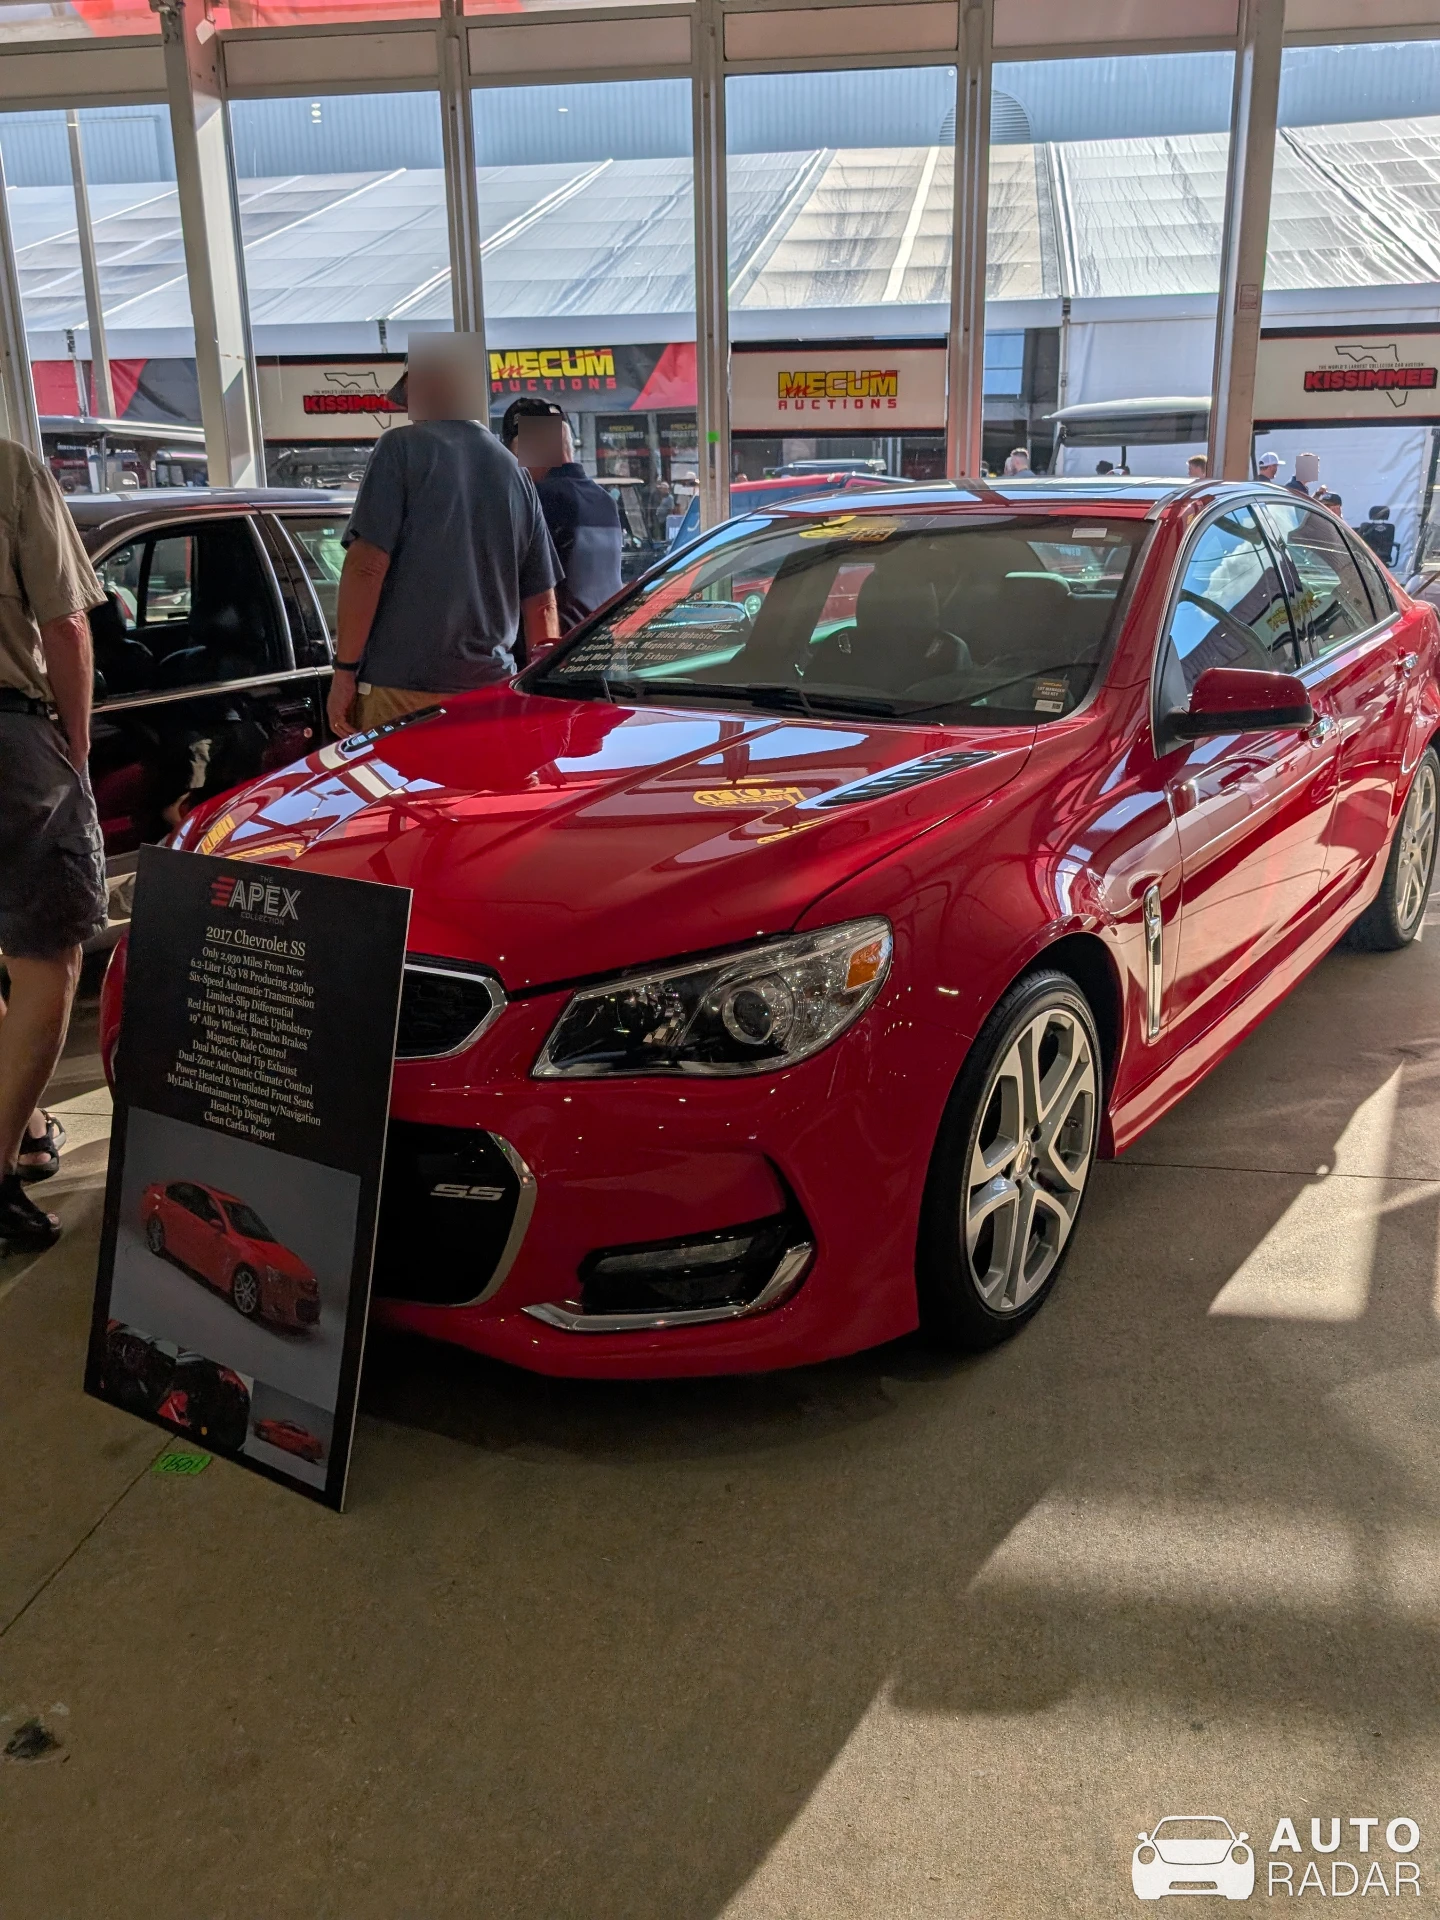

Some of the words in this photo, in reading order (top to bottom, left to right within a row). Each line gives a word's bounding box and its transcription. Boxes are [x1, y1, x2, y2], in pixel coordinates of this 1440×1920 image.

[489, 348, 615, 380] MECUM
[1304, 367, 1438, 392] KISSIMMEE
[491, 377, 616, 393] AUCTIONS
[778, 370, 897, 398] MECUM
[778, 398, 897, 410] AUCTIONS
[229, 880, 301, 920] APEX
[240, 911, 285, 926] COLLECTION
[206, 926, 232, 944] 2017
[234, 929, 288, 954] Chevrolet
[290, 940, 306, 957] SS
[190, 958, 221, 974] 6.2-Liter
[223, 965, 236, 979] LS3
[238, 967, 248, 980] V8
[250, 972, 288, 991] Producing
[289, 982, 314, 997] 430hp
[202, 946, 219, 960] Only
[242, 955, 262, 969] Miles
[264, 960, 284, 974] From
[286, 965, 304, 978] New
[189, 971, 224, 988] Six-Speed
[225, 979, 263, 997] Automatic
[264, 988, 315, 1009] Transmission
[206, 989, 250, 1009] Limited-Slip
[251, 1000, 294, 1019] Differential
[187, 998, 201, 1010] Red
[202, 1001, 216, 1013] Hot
[217, 1004, 235, 1018] With
[236, 1010, 248, 1022] Jet
[249, 1013, 269, 1027] Black
[270, 1018, 312, 1039] Upholstery
[201, 1016, 220, 1030] Alloy
[221, 1019, 249, 1037] Wheels,
[251, 1028, 280, 1044] Brembo
[281, 1034, 307, 1050] Brakes
[192, 1040, 209, 1053] Dual
[210, 1045, 231, 1058] Mode
[231, 1049, 251, 1064] Quad
[253, 1056, 266, 1070] Tip
[267, 1060, 298, 1077] Exhaust
[206, 1030, 239, 1047] Magnetic
[240, 1038, 257, 1052] Ride
[258, 1044, 287, 1060] Control
[175, 1062, 197, 1076] Power
[199, 1069, 224, 1084] Heated
[225, 1076, 232, 1086] &
[232, 1078, 270, 1098] Ventilated
[271, 1088, 292, 1103] Front
[293, 1096, 314, 1110] Seats
[178, 1049, 215, 1068] Dual-Zone
[215, 1060, 253, 1077] Automatic
[254, 1070, 283, 1087] Climate
[284, 1079, 313, 1095] Control
[167, 1073, 194, 1090] MyLink
[195, 1082, 241, 1103] Infotainment
[242, 1094, 269, 1111] System
[270, 1103, 321, 1126] w/Navigation
[210, 1099, 243, 1118] Head-Up
[244, 1108, 272, 1127] Display
[204, 1111, 225, 1126] Clean
[225, 1118, 249, 1133] Carfax
[250, 1124, 275, 1141] Report
[430, 1183, 506, 1201] SS
